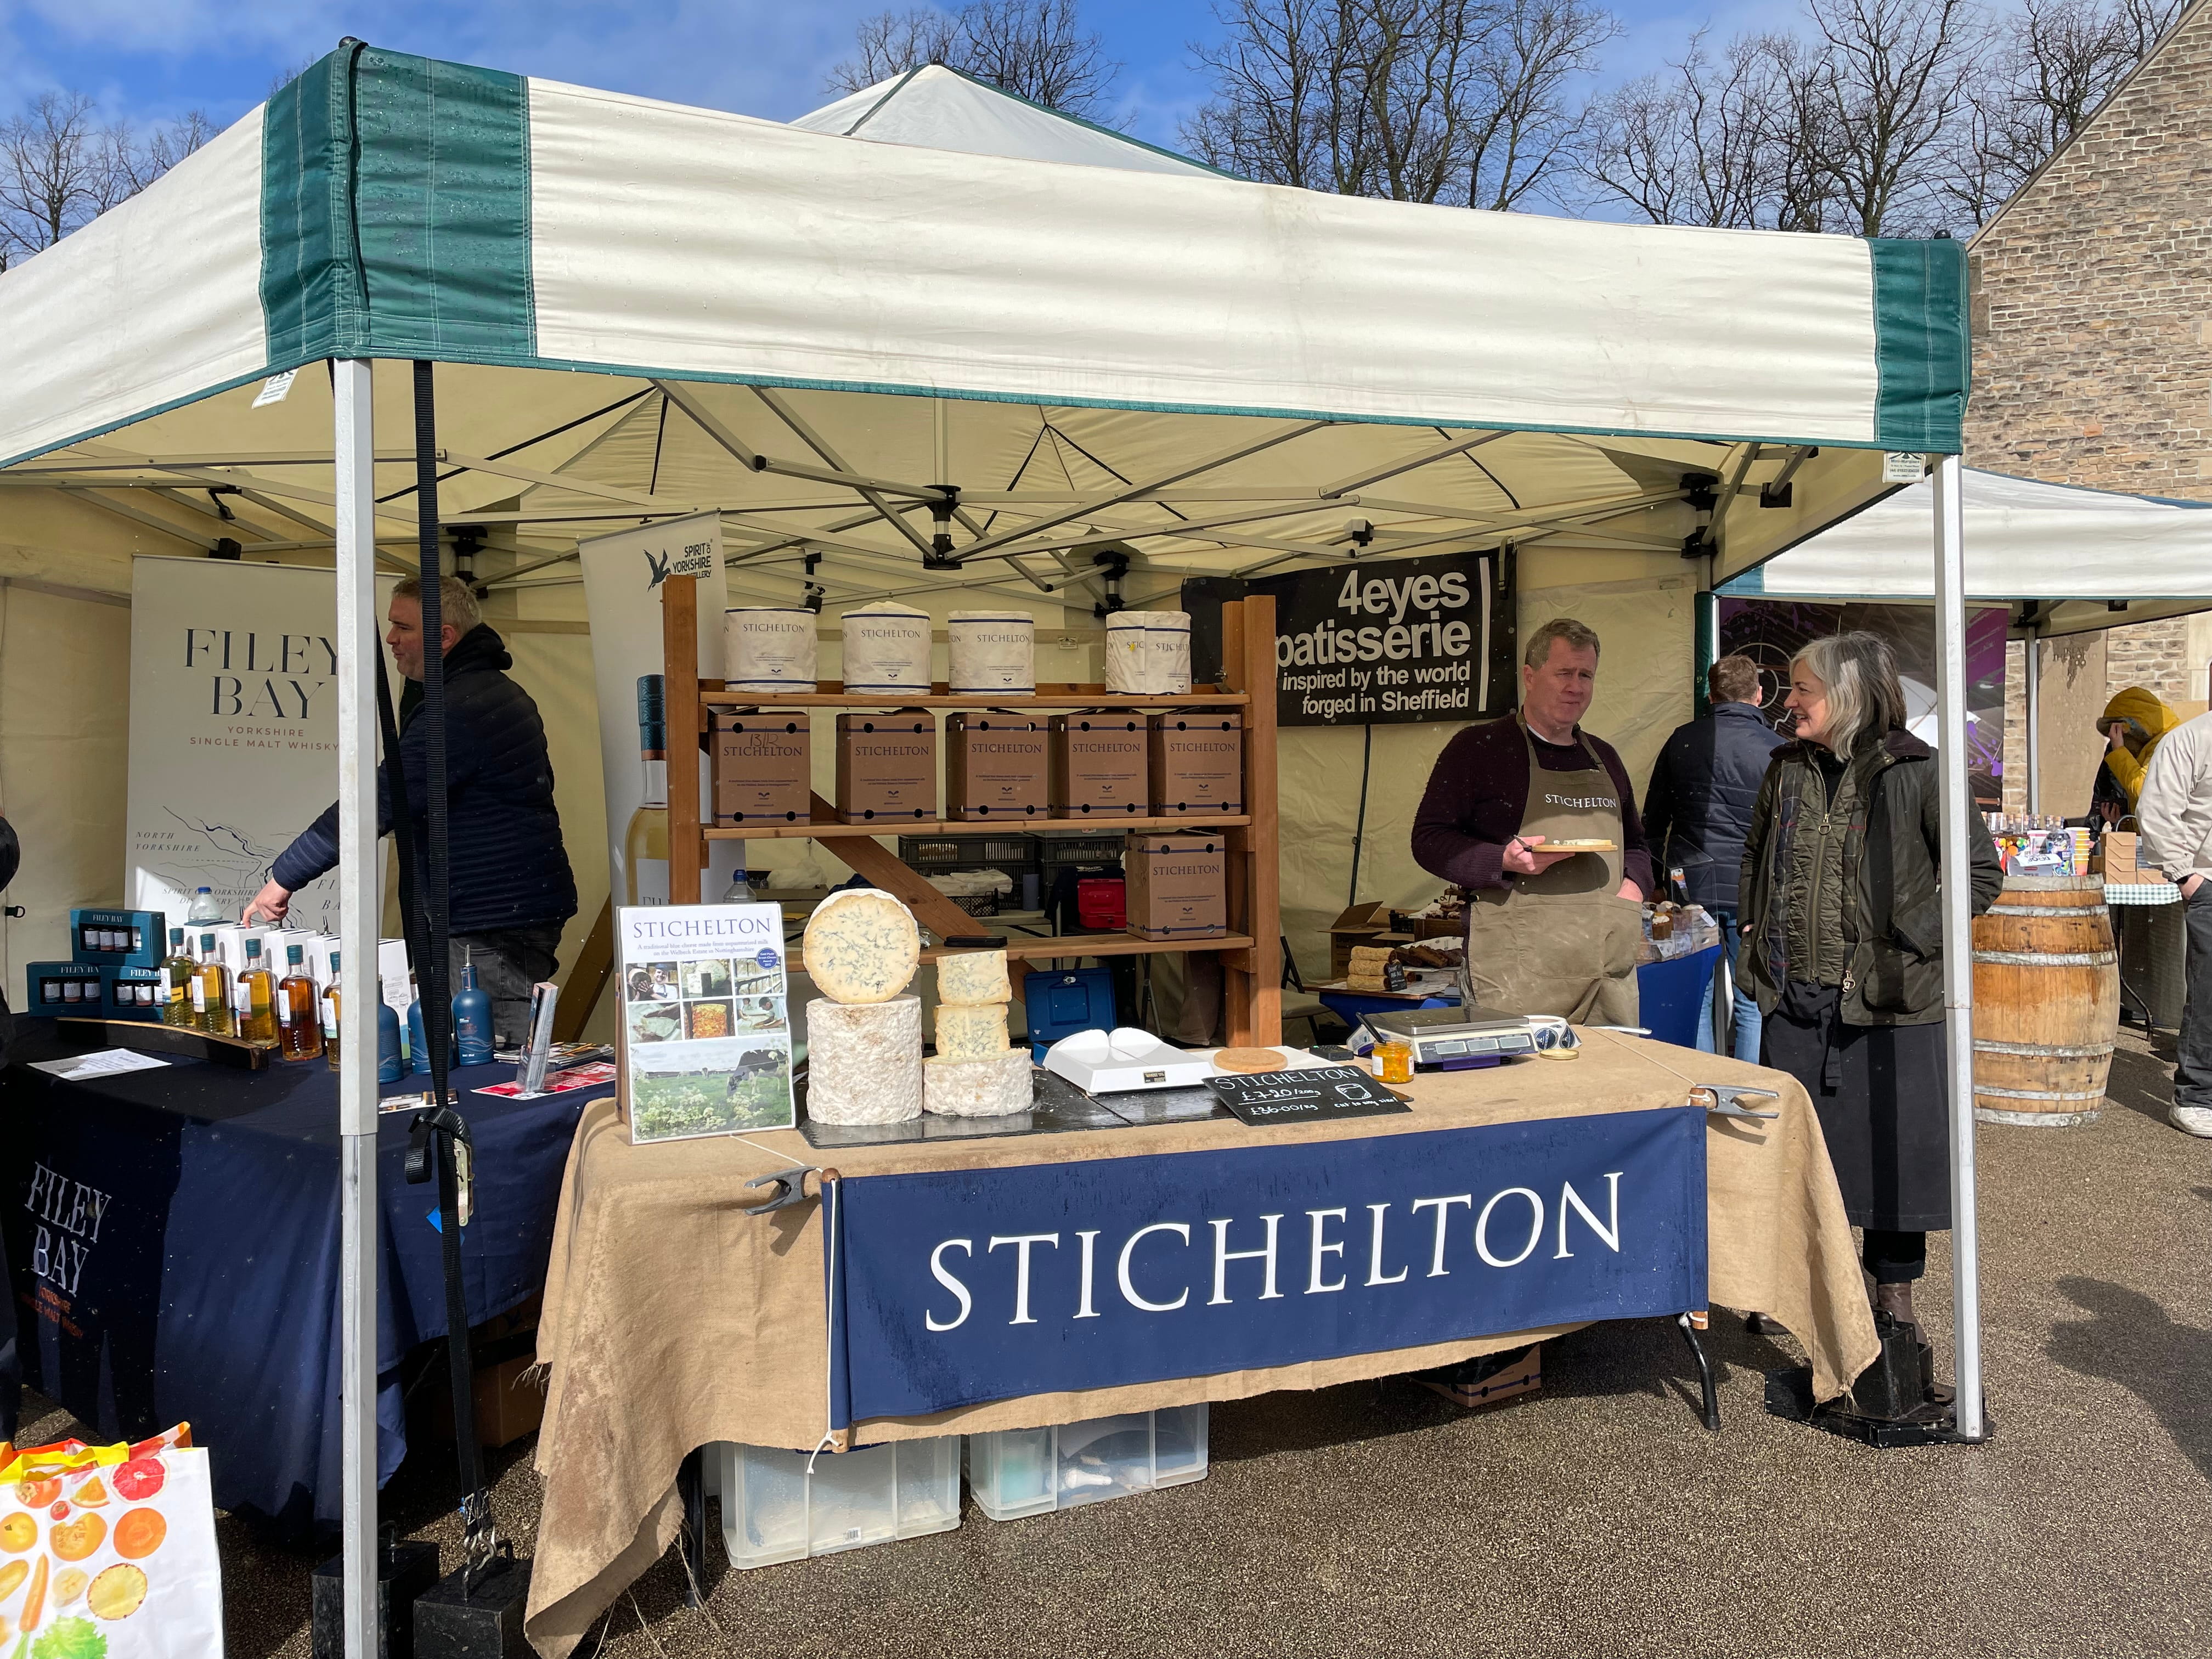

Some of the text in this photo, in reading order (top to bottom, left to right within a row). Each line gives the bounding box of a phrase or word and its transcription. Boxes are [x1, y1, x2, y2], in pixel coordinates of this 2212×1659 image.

[684, 543, 706, 558] SPIRIT
[673, 555, 712, 574] YORKSHIRE
[1338, 569, 1470, 625] 4eyes
[743, 623, 805, 633] STICHELTON
[861, 629, 921, 638] STICHELTON
[977, 634, 1030, 642] STICHELTON
[1275, 610, 1471, 679] patisserie
[1283, 660, 1471, 694] inspired by the world
[211, 675, 326, 719] BAY
[1302, 687, 1470, 719] forged in Sheffield
[228, 726, 304, 737] YORKSHIRE
[190, 737, 338, 751] SINGLE MALT WHISKY
[724, 746, 803, 756] STICHELTON
[855, 746, 929, 756] STICHELTON
[972, 743, 1042, 753] STICHELTON
[1073, 743, 1141, 753] STICHELTON
[1170, 742, 1235, 752] STICHELTON
[1545, 793, 1617, 808] STICHELTON
[136, 831, 174, 839] NORTH
[136, 843, 201, 852] YORKSHIRE
[1153, 865, 1220, 876] STICHELTON
[633, 918, 771, 939] STICHELTON
[1214, 1068, 1361, 1090] STICHELTON
[25, 1161, 112, 1244] FILEY
[925, 1171, 1624, 1333] STICHELTON
[31, 1223, 89, 1297] BAY
